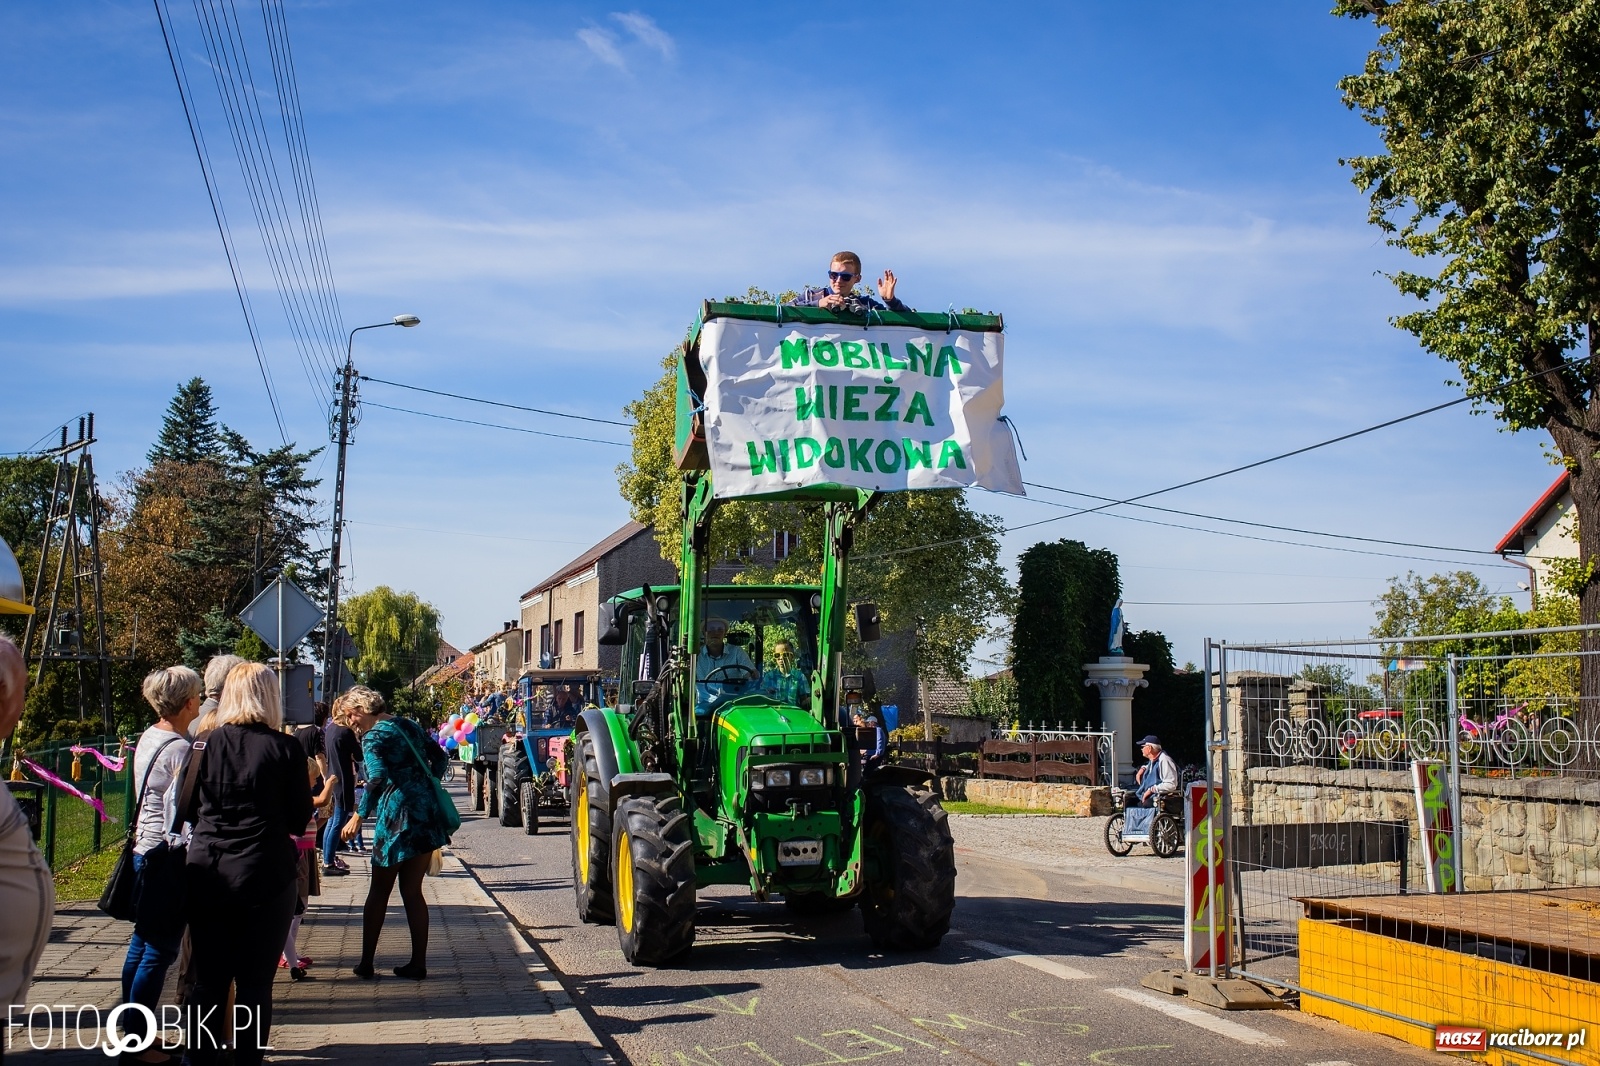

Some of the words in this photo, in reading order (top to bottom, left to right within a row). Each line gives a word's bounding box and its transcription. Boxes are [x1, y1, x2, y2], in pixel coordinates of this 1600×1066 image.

[780, 338, 963, 377] MOBILNA
[795, 376, 934, 427] WIEŻA
[746, 436, 967, 476] WIDOKOWA
